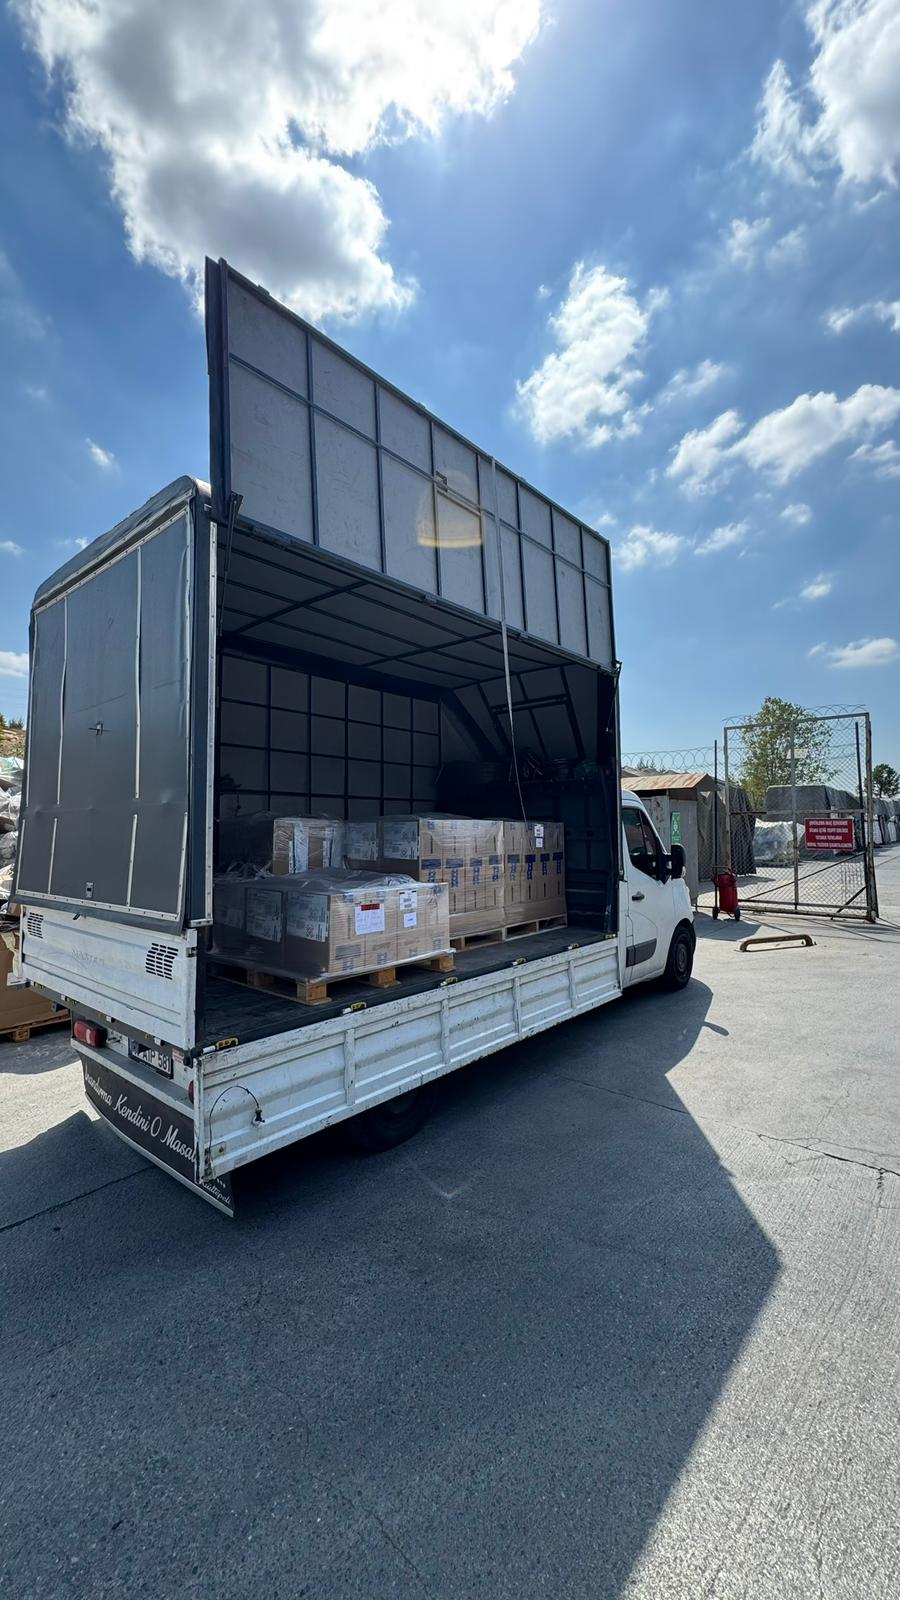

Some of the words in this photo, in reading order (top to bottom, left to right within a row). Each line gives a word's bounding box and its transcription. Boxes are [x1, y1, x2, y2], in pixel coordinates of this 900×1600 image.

[113, 1093, 151, 1132] Kendini
[150, 1116, 162, 1137] O
[160, 1124, 197, 1163] Masal
